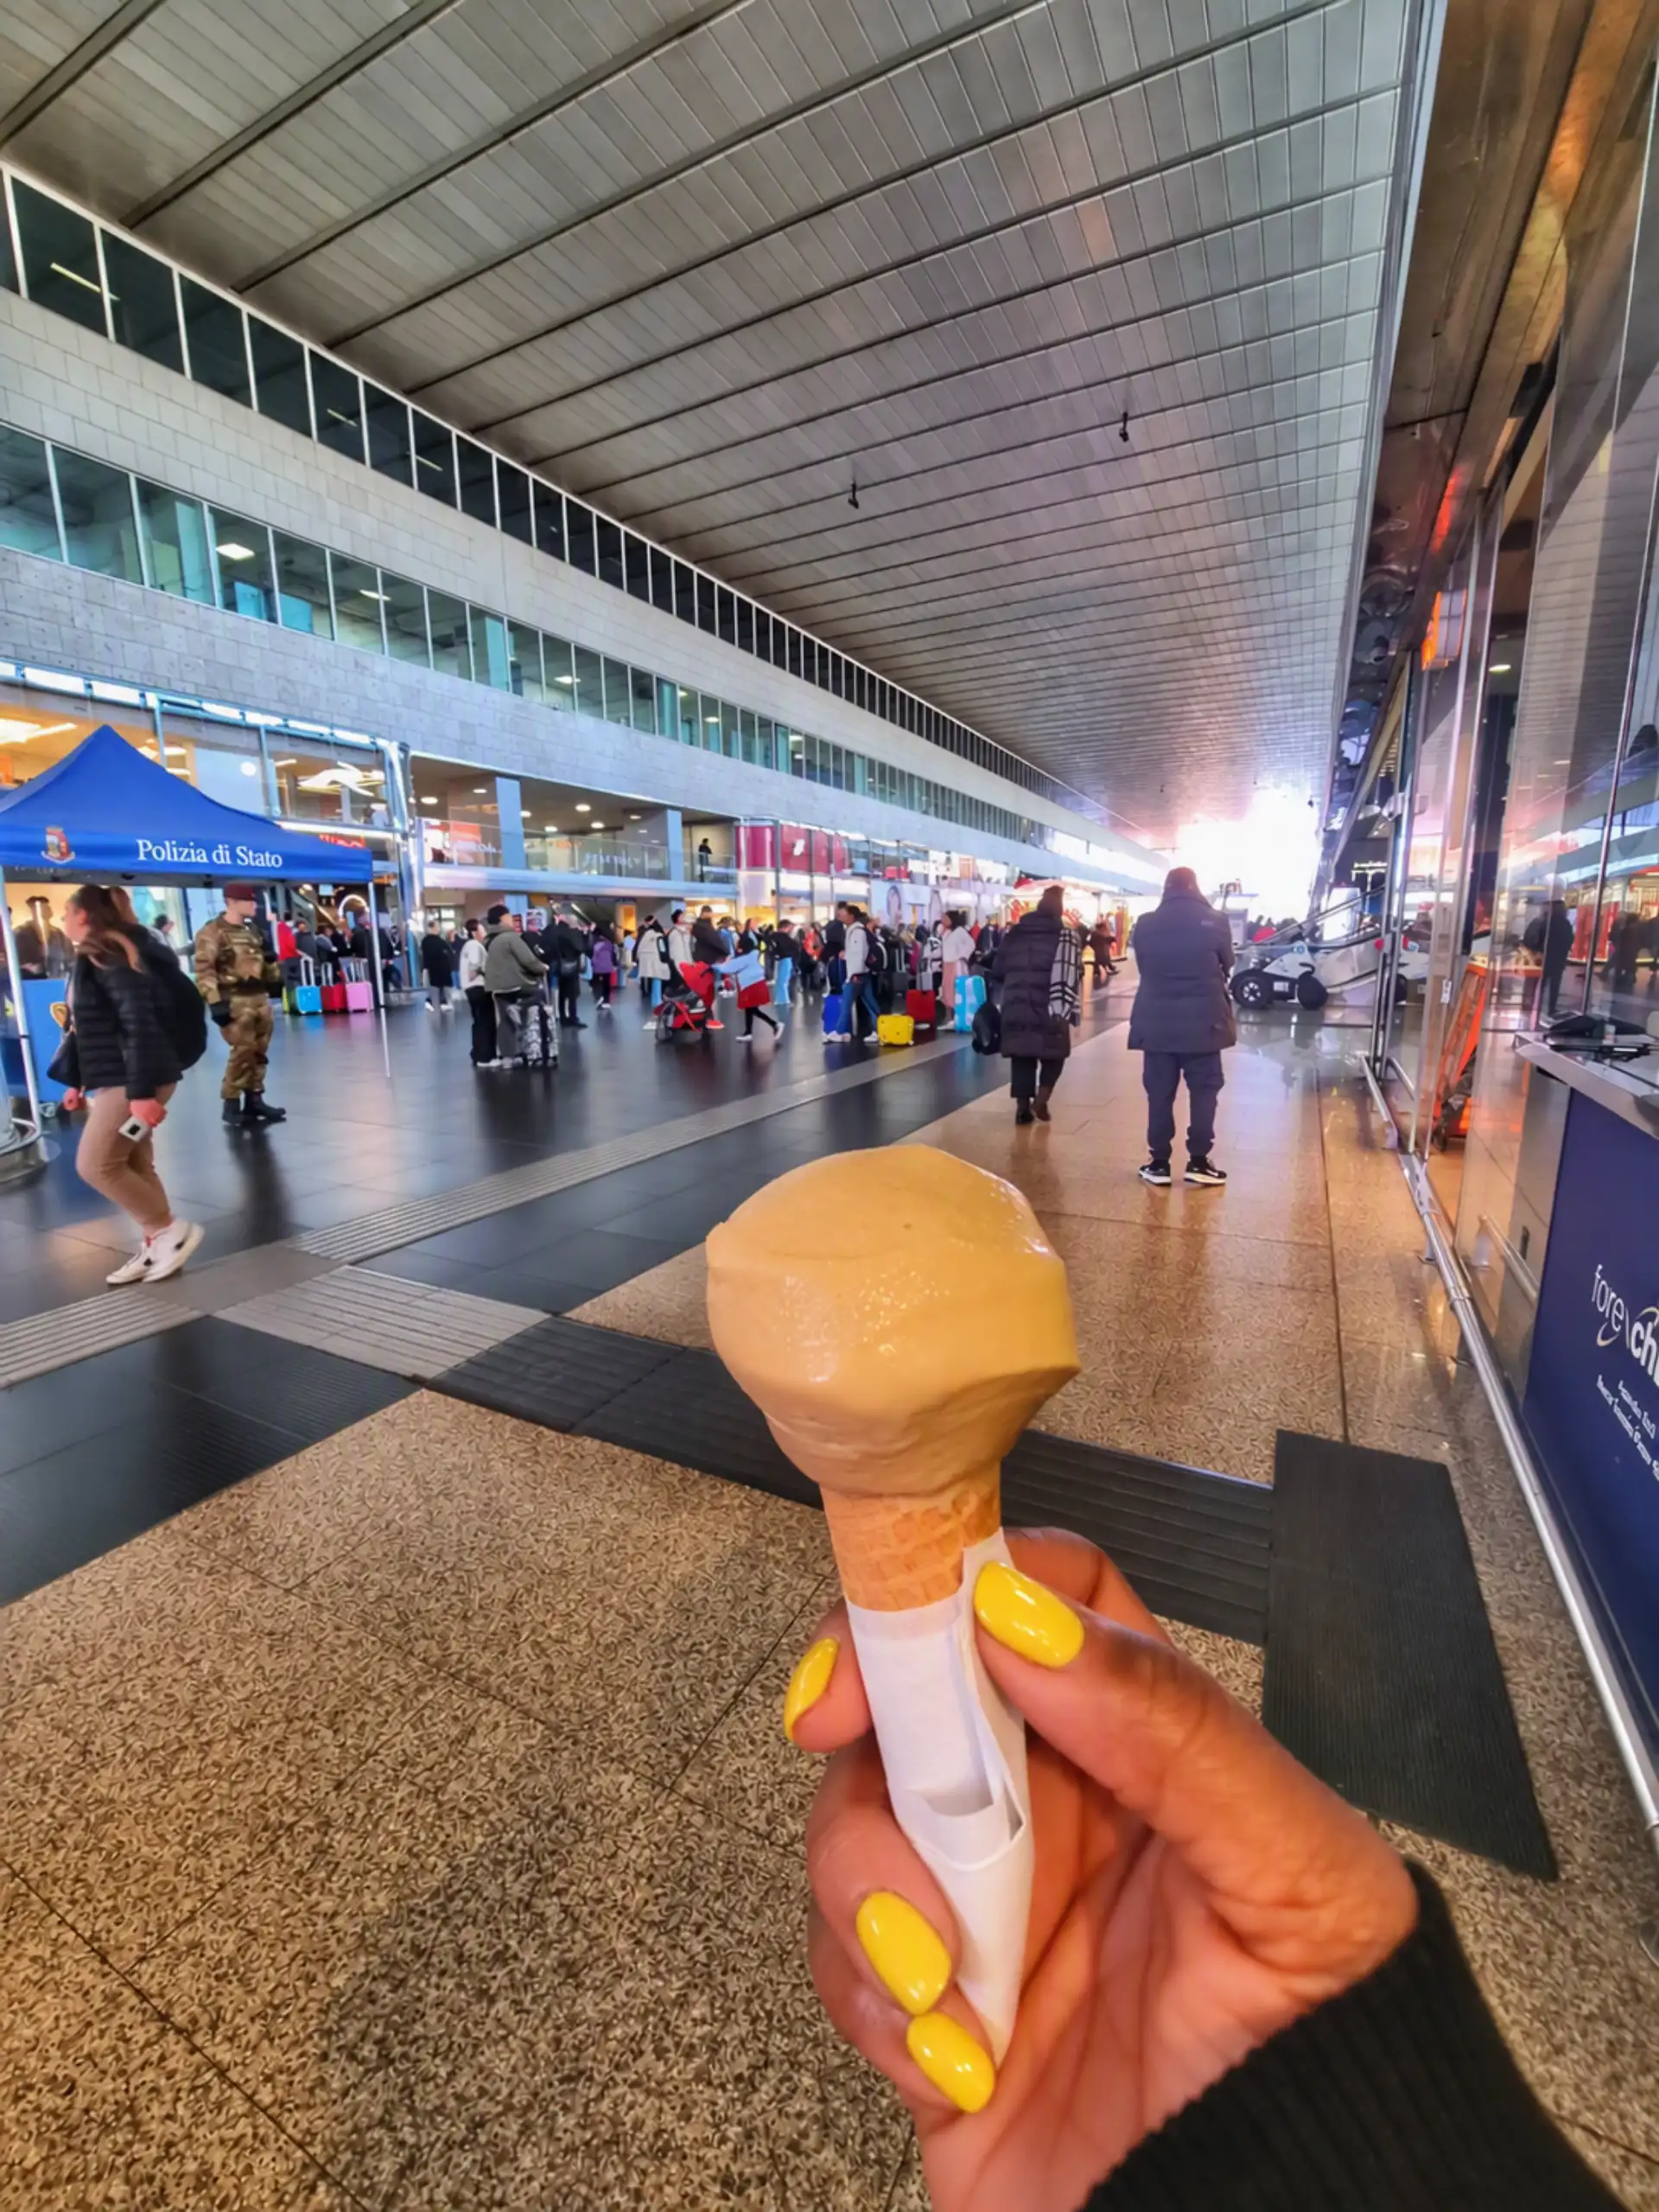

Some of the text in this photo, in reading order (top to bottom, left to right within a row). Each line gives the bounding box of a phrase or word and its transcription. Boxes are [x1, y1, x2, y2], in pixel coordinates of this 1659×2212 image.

[137, 839, 283, 868] Polizia di Stato
